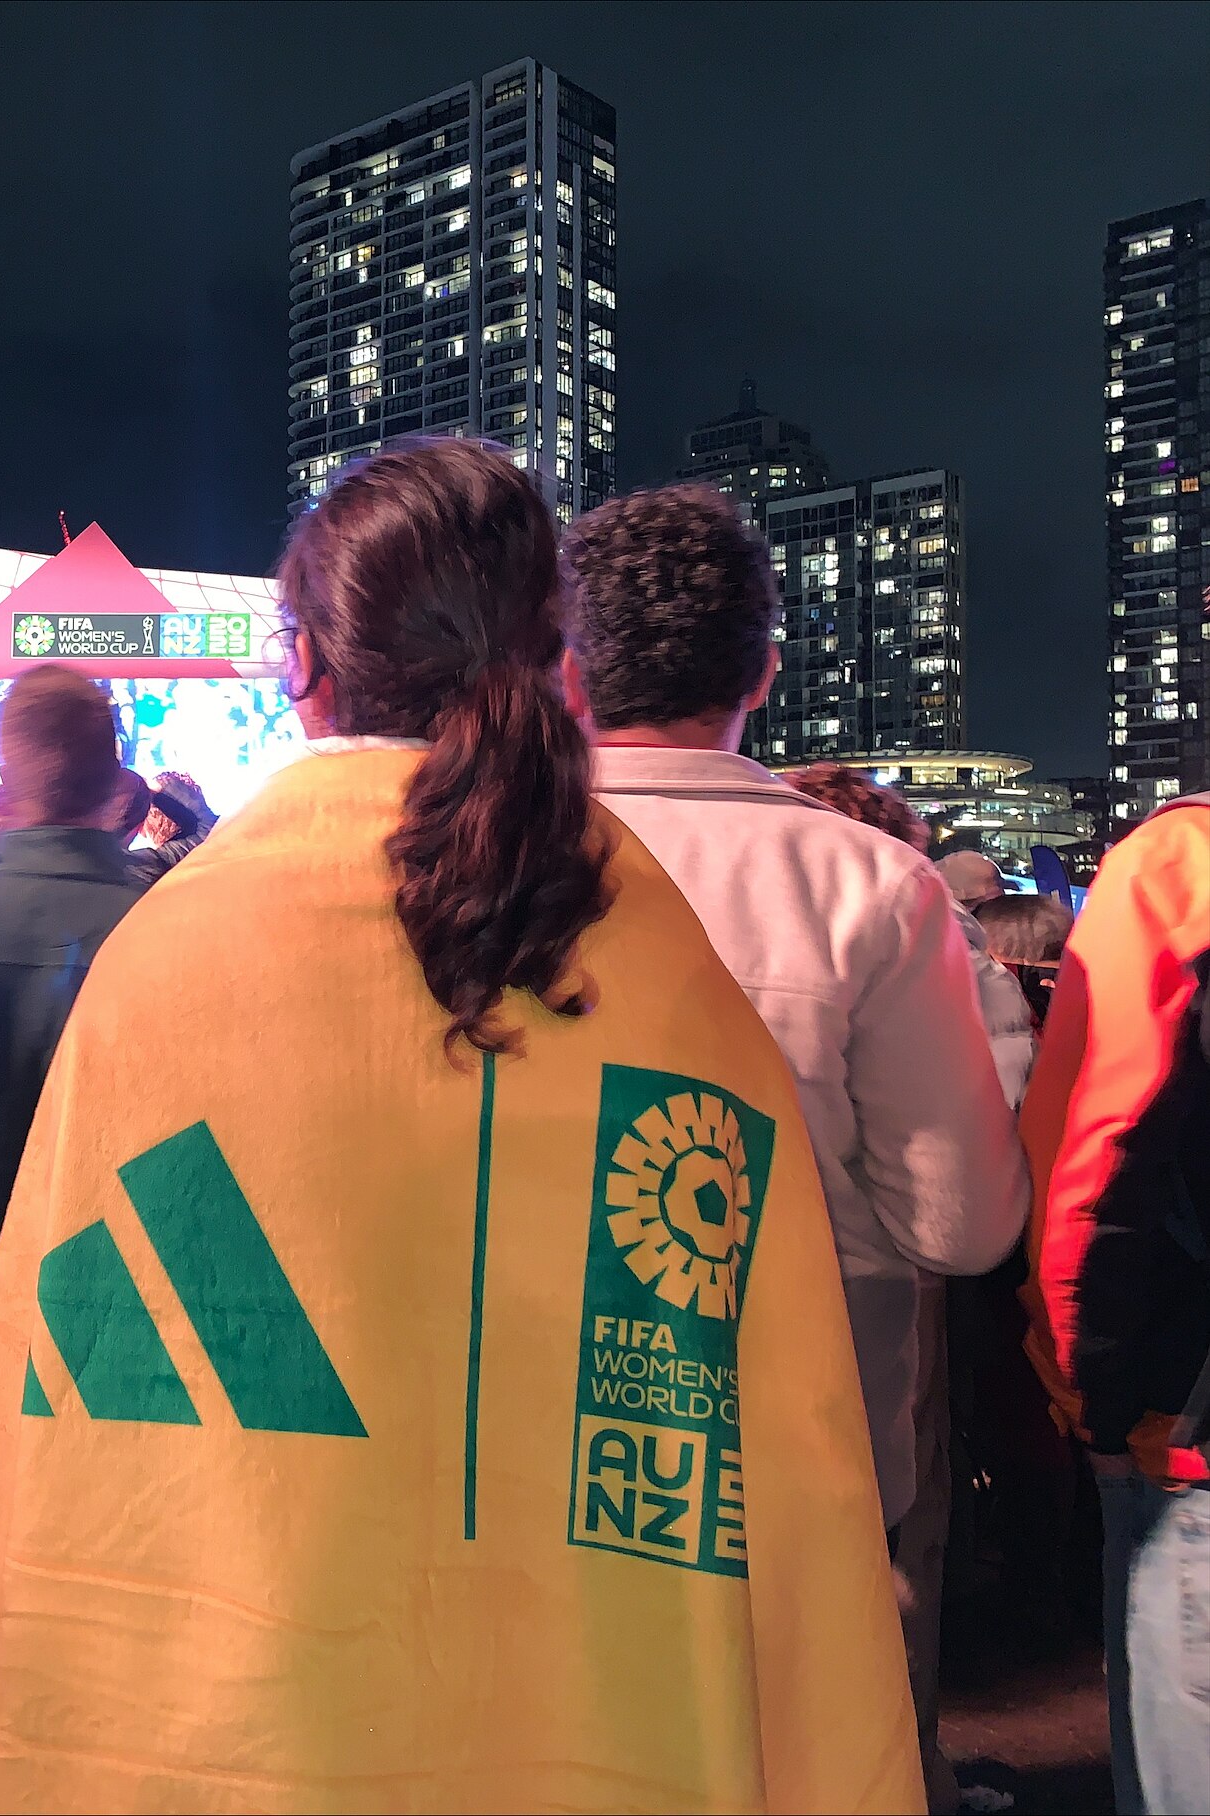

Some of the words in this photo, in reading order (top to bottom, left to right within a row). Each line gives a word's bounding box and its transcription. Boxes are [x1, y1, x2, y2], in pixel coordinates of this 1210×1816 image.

[58, 617, 93, 630] FIFA
[164, 616, 201, 635] AU
[208, 616, 247, 635] 20
[58, 631, 125, 642] WOMEN'S
[164, 636, 201, 655] NZ
[208, 635, 247, 654] 23
[58, 643, 108, 655] WORLD
[109, 643, 139, 655] CUP
[593, 1315, 677, 1353] FIFA
[593, 1348, 738, 1396] WOMEN'S
[591, 1377, 713, 1420] WORLD
[719, 1398, 740, 1426] C
[588, 1428, 694, 1490] AU
[585, 1481, 689, 1550] NZ
